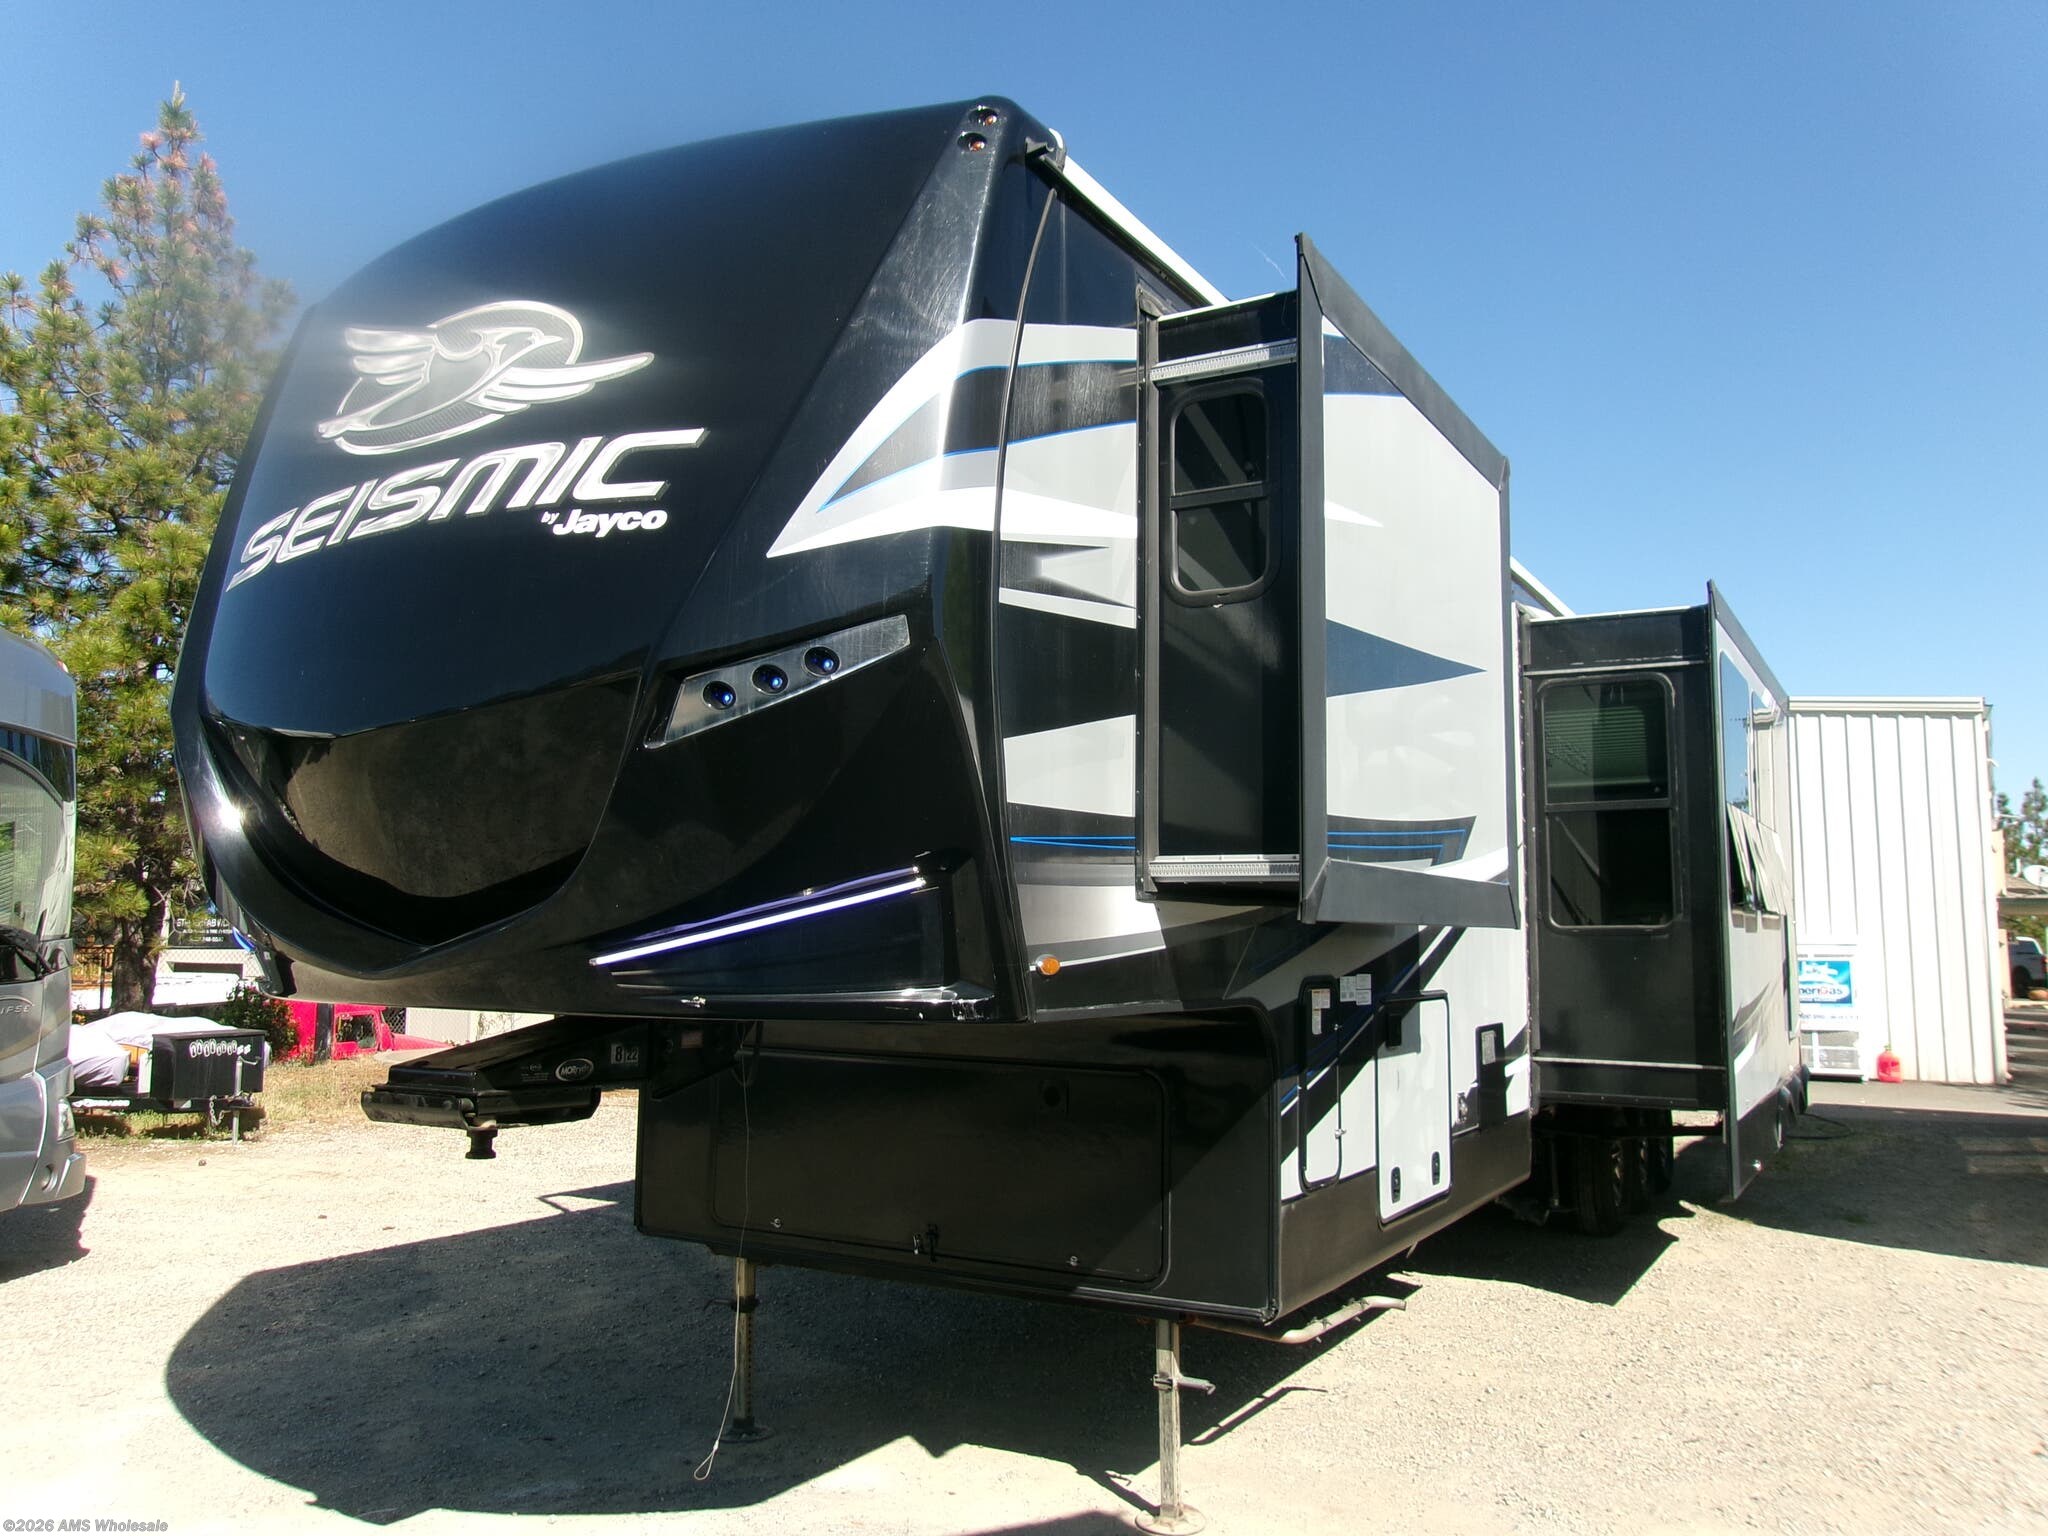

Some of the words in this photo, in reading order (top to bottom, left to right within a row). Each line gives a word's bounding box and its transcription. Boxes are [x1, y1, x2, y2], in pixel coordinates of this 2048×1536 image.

[226, 428, 708, 591] SEISMIC
[541, 511, 560, 524] by
[553, 509, 668, 538] Jayco
